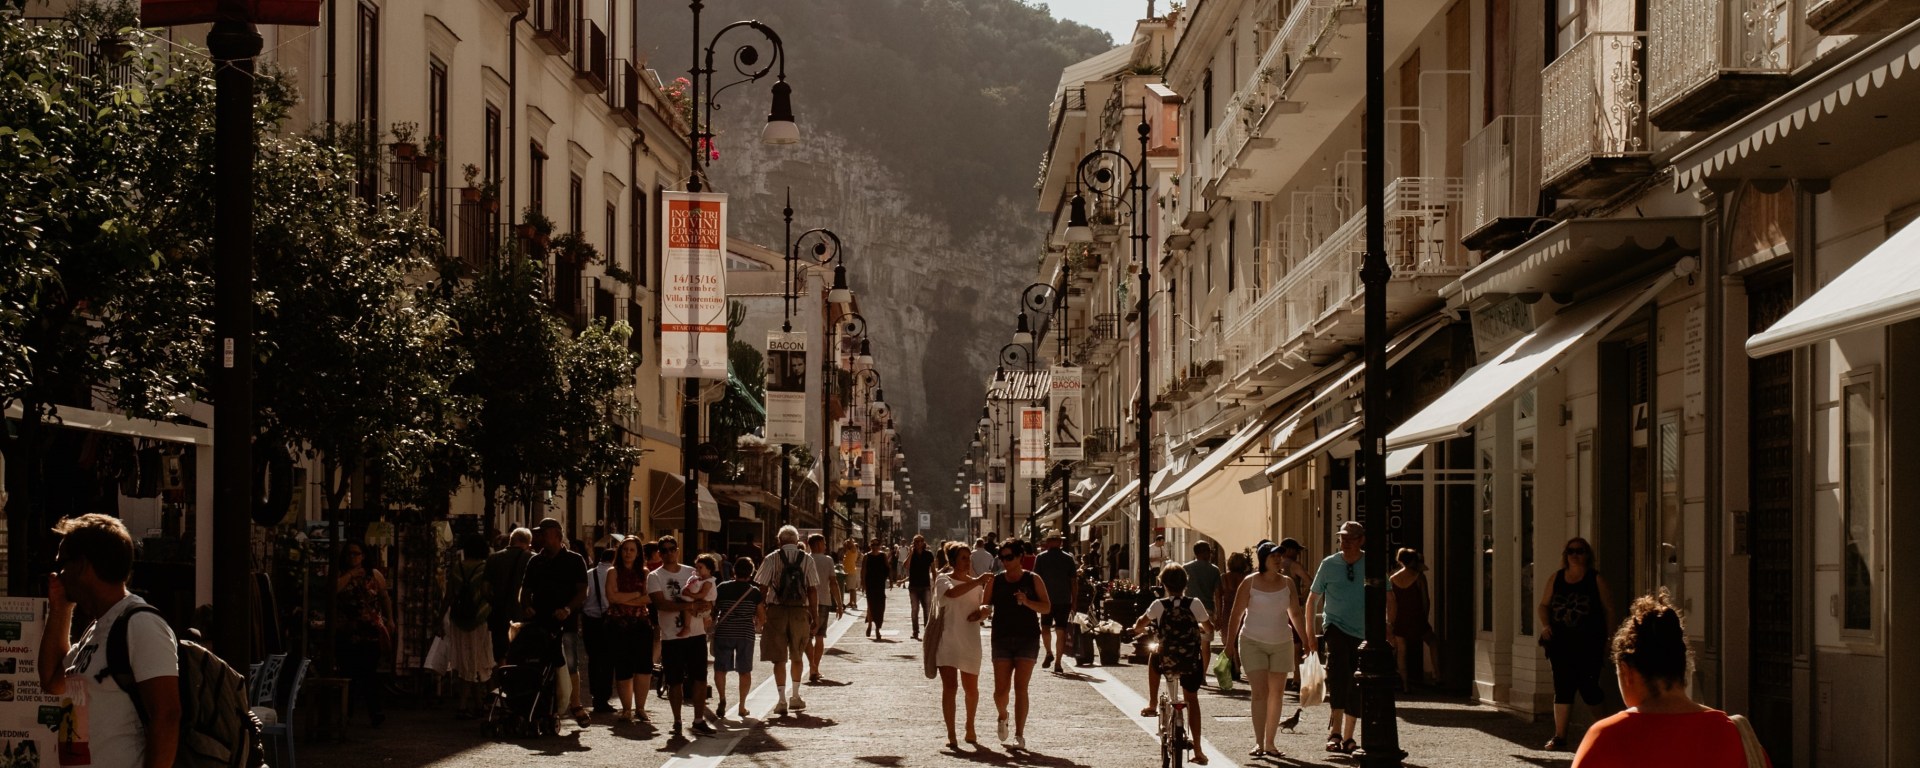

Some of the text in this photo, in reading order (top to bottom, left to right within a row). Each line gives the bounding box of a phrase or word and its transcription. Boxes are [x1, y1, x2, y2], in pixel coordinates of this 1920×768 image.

[671, 209, 718, 219] INCONTRI
[671, 218, 718, 229] DI VINI
[689, 228, 718, 236] SAPORI
[670, 234, 718, 245] CAMPANI
[673, 274, 717, 284] 14/15/16
[673, 284, 716, 292] settembre
[665, 294, 723, 303] Villa Fiorentino
[769, 341, 804, 350] BACON
[1052, 381, 1080, 389] BACON
